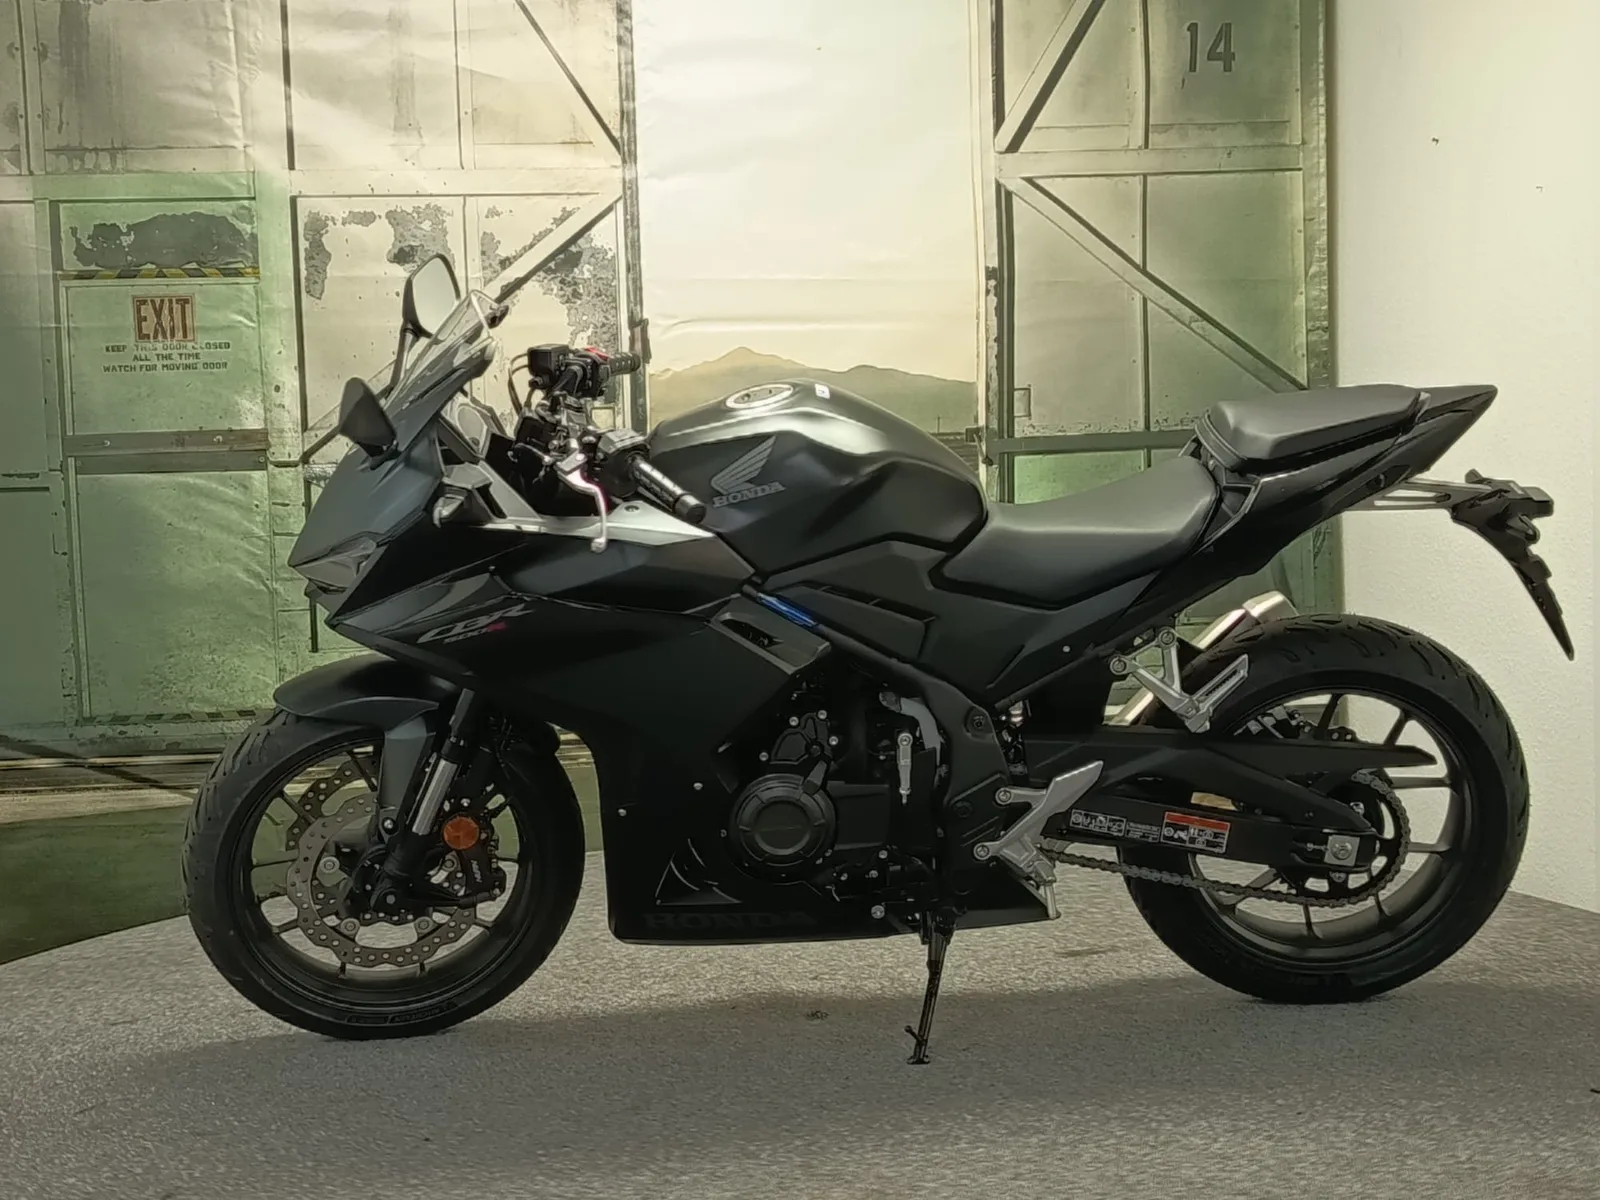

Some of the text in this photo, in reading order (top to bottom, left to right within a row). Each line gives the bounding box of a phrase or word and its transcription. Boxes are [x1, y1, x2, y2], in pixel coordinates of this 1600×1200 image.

[1187, 22, 1236, 73] 14
[135, 298, 190, 340] EXIT
[105, 344, 127, 353] KEEP
[132, 352, 201, 362] ALL THE TIME
[103, 361, 229, 373] WATCH FOR MOVING DOOR
[712, 481, 786, 508] HONDA
[416, 603, 535, 644] CBR
[642, 910, 819, 930] HONDA
